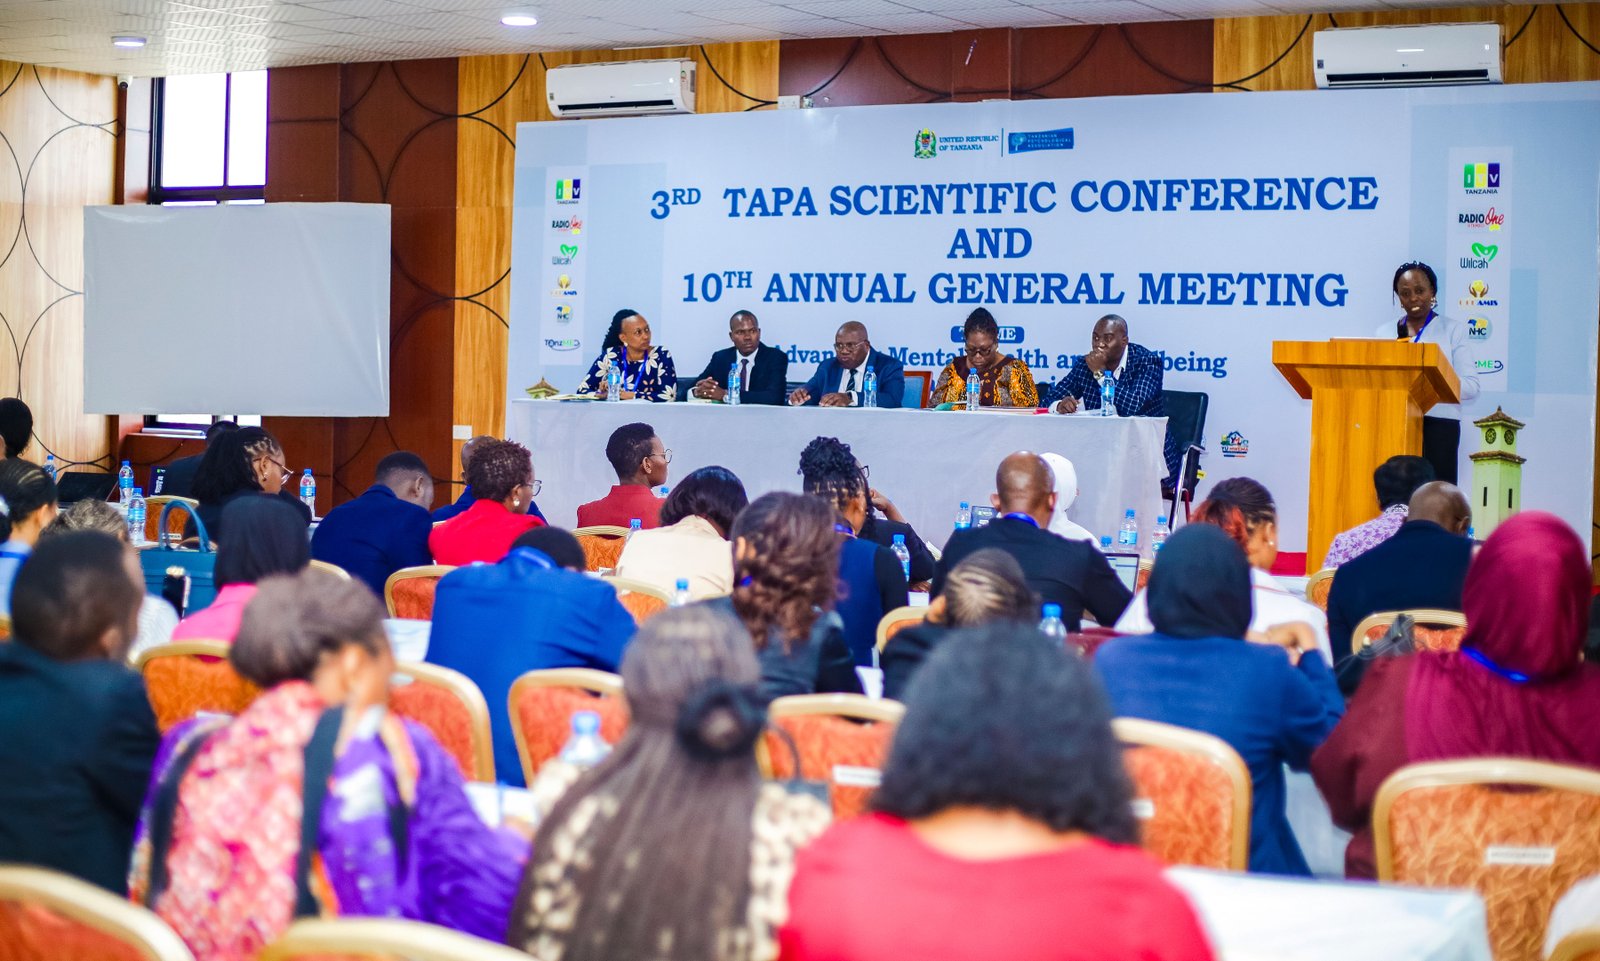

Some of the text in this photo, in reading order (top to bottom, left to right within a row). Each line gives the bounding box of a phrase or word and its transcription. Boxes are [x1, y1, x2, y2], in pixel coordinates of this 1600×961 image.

[723, 186, 818, 217] TAPA
[829, 181, 1057, 216] SCIENTIFIC
[1070, 176, 1380, 213] CONFERENCE
[551, 220, 570, 228] RADIO
[1458, 206, 1504, 225] RADIO One
[946, 227, 1033, 259] AND
[1459, 257, 1489, 269] Wilcah
[763, 272, 917, 303] ANNUAL
[928, 272, 1126, 304] GENERAL
[1138, 272, 1349, 307] MEETING
